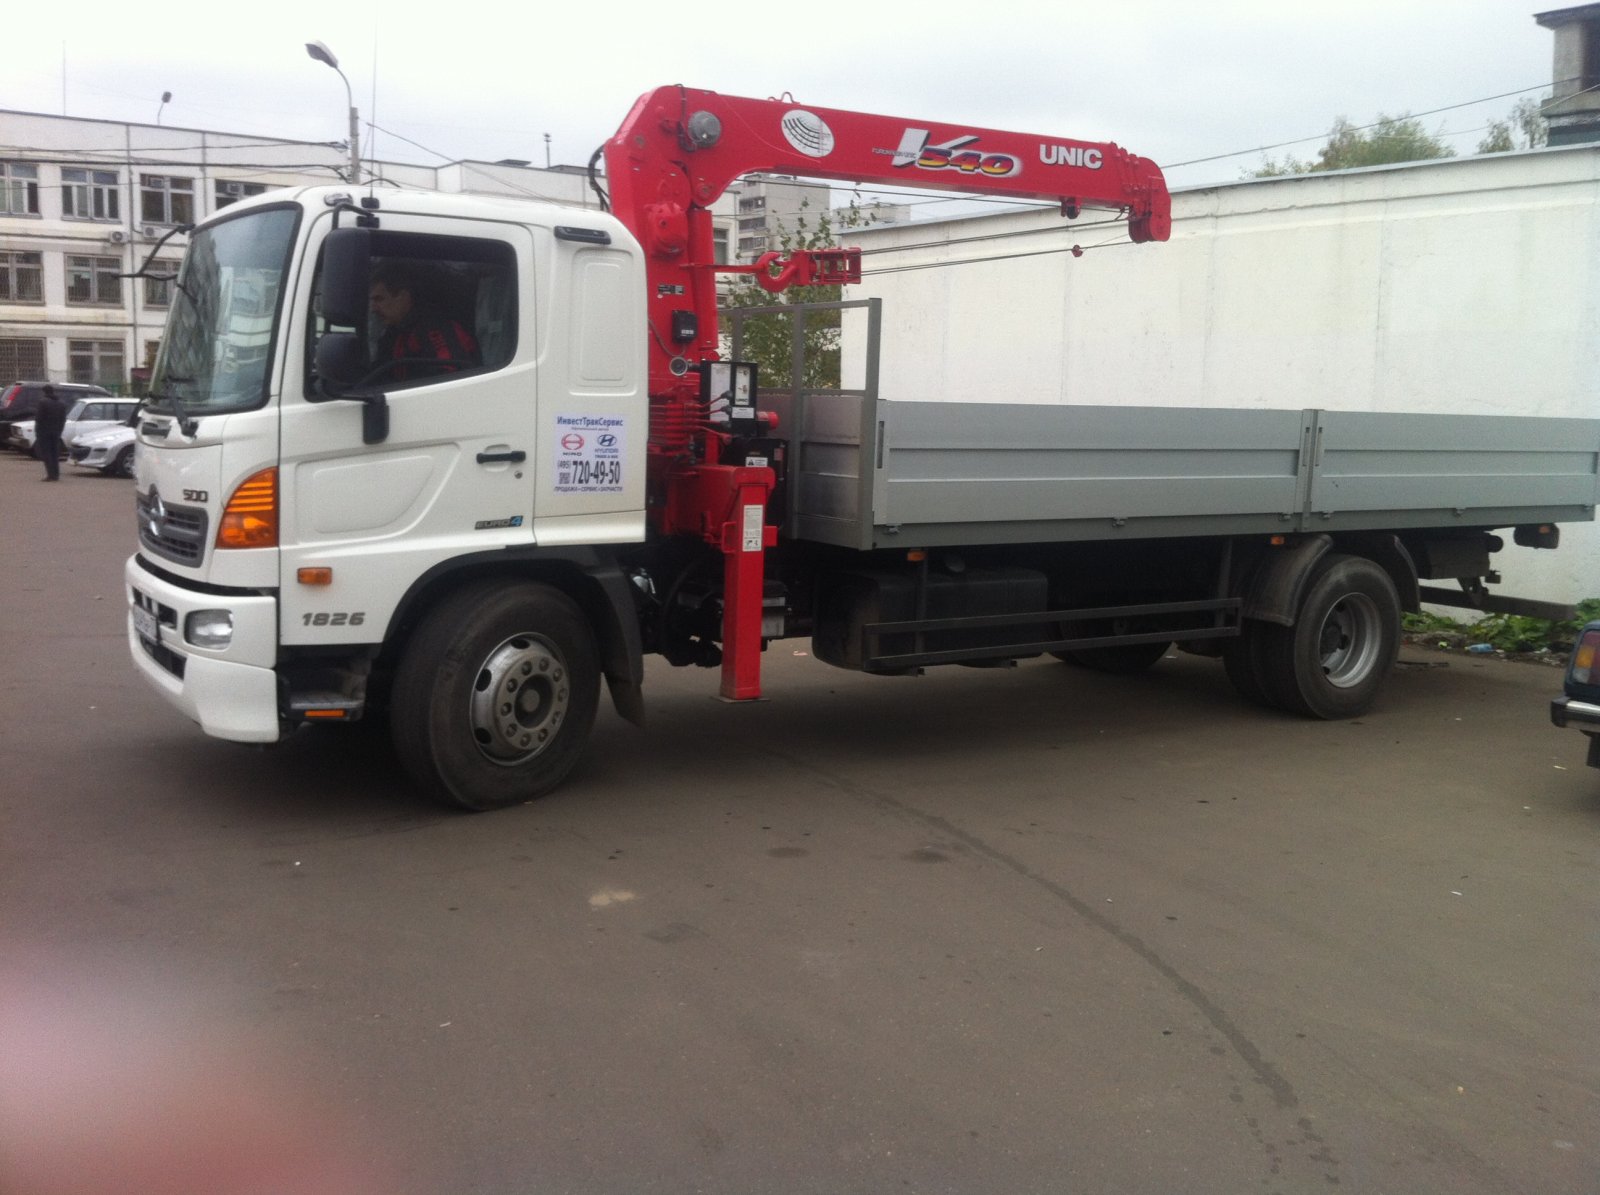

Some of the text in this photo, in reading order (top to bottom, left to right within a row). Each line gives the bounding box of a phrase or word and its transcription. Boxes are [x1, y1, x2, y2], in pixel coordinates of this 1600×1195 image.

[918, 147, 1014, 176] 540
[1039, 143, 1103, 170] UNIC
[557, 416, 623, 427] ИнвестТракСервис
[572, 460, 621, 485] 720-49-50
[182, 489, 208, 502] 500
[302, 611, 364, 627] 1826
